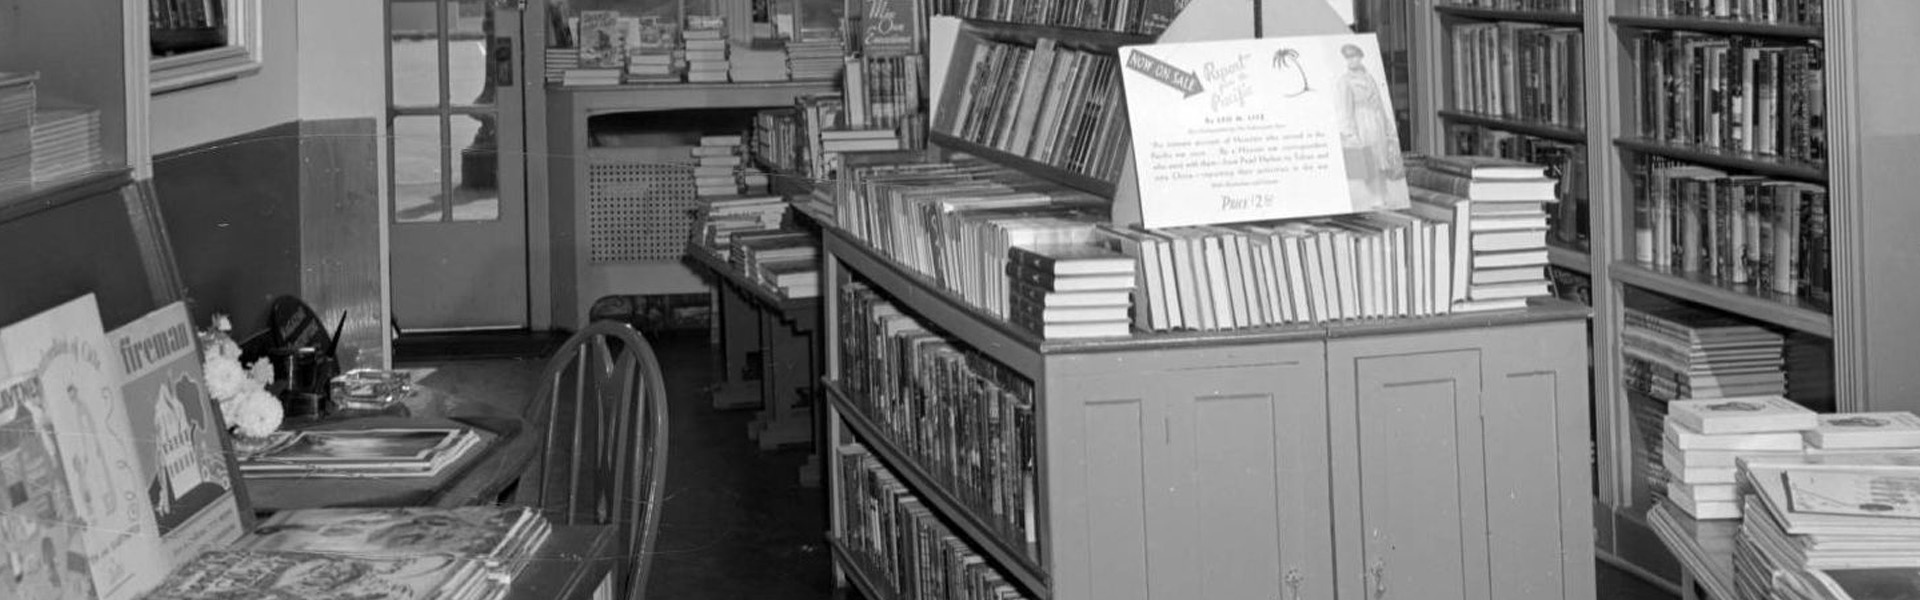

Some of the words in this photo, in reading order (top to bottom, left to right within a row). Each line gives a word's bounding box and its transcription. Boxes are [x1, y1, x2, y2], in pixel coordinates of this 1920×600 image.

[1130, 53, 1153, 72] NOW
[1155, 62, 1171, 80] ON
[1172, 71, 1195, 91] SALE
[120, 322, 190, 375] fireman
